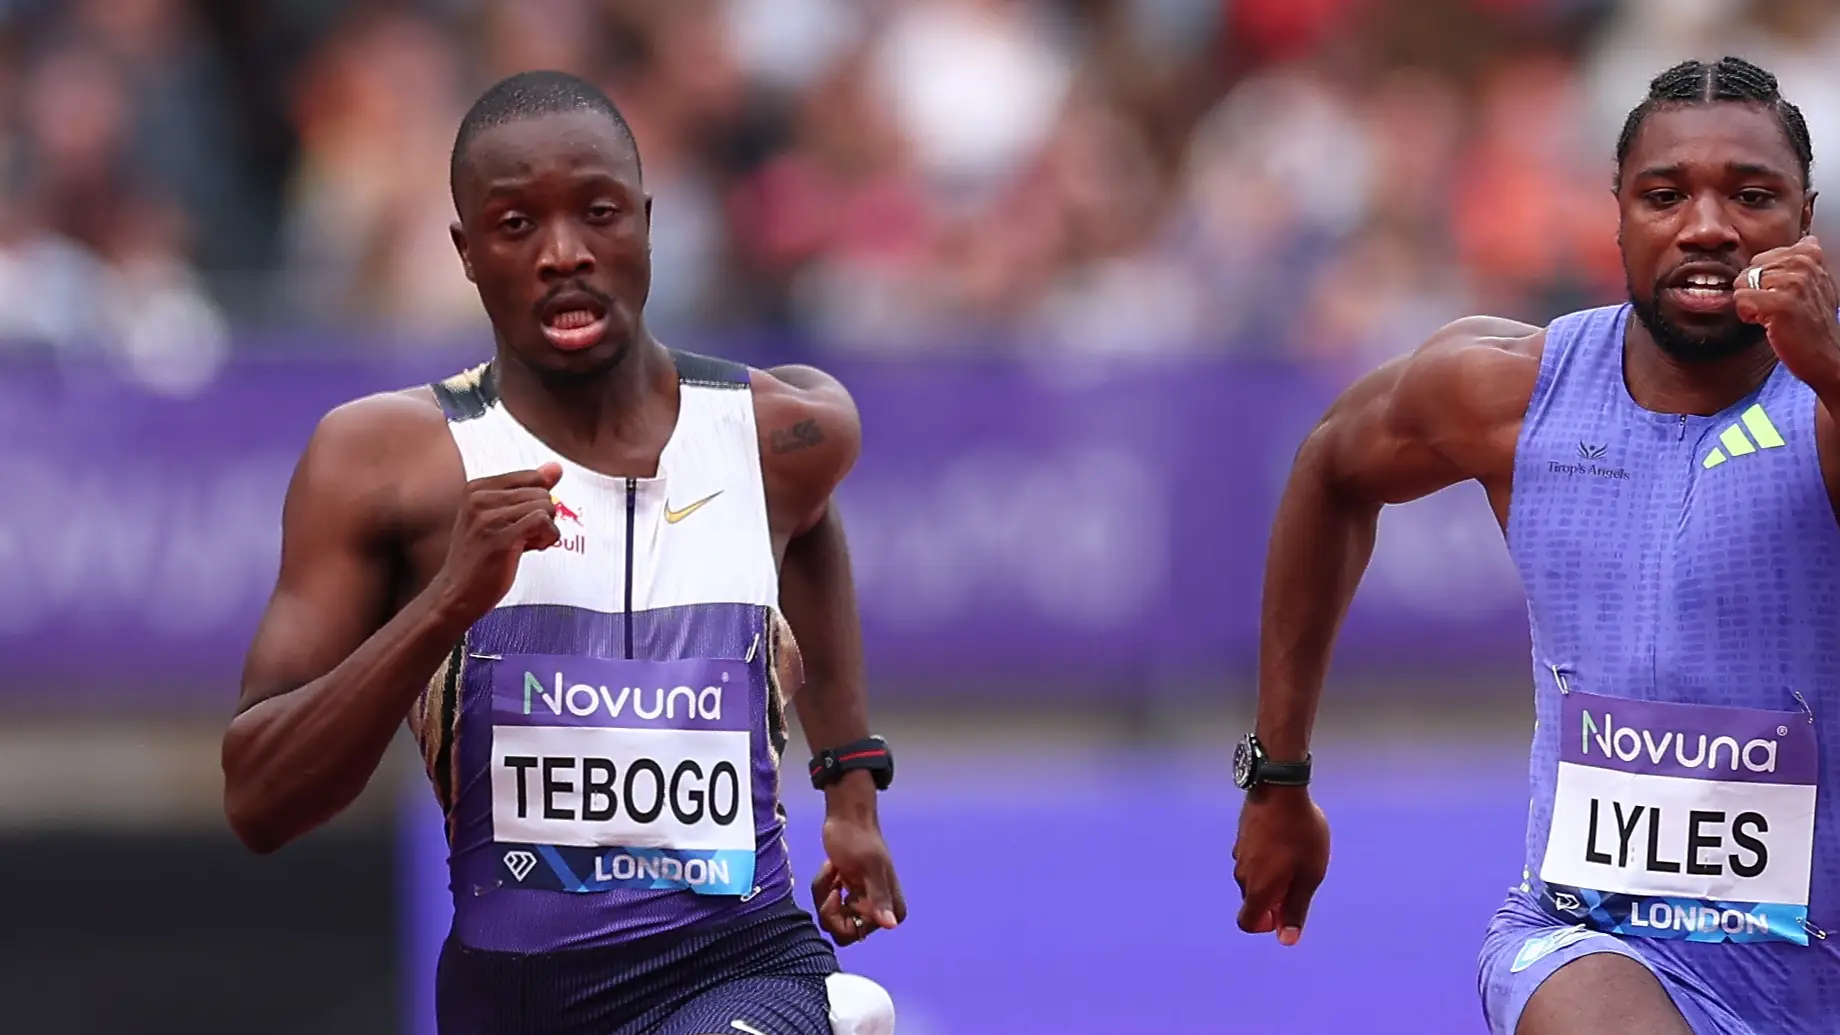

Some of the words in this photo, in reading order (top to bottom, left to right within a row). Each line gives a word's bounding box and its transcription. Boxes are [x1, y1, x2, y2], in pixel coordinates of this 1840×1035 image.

[1588, 464, 1631, 481] Angels
[503, 755, 740, 827] TEBOGO
[1585, 797, 1769, 879] LYLES
[594, 854, 730, 886] LONDON
[1630, 901, 1769, 935] LONDON
